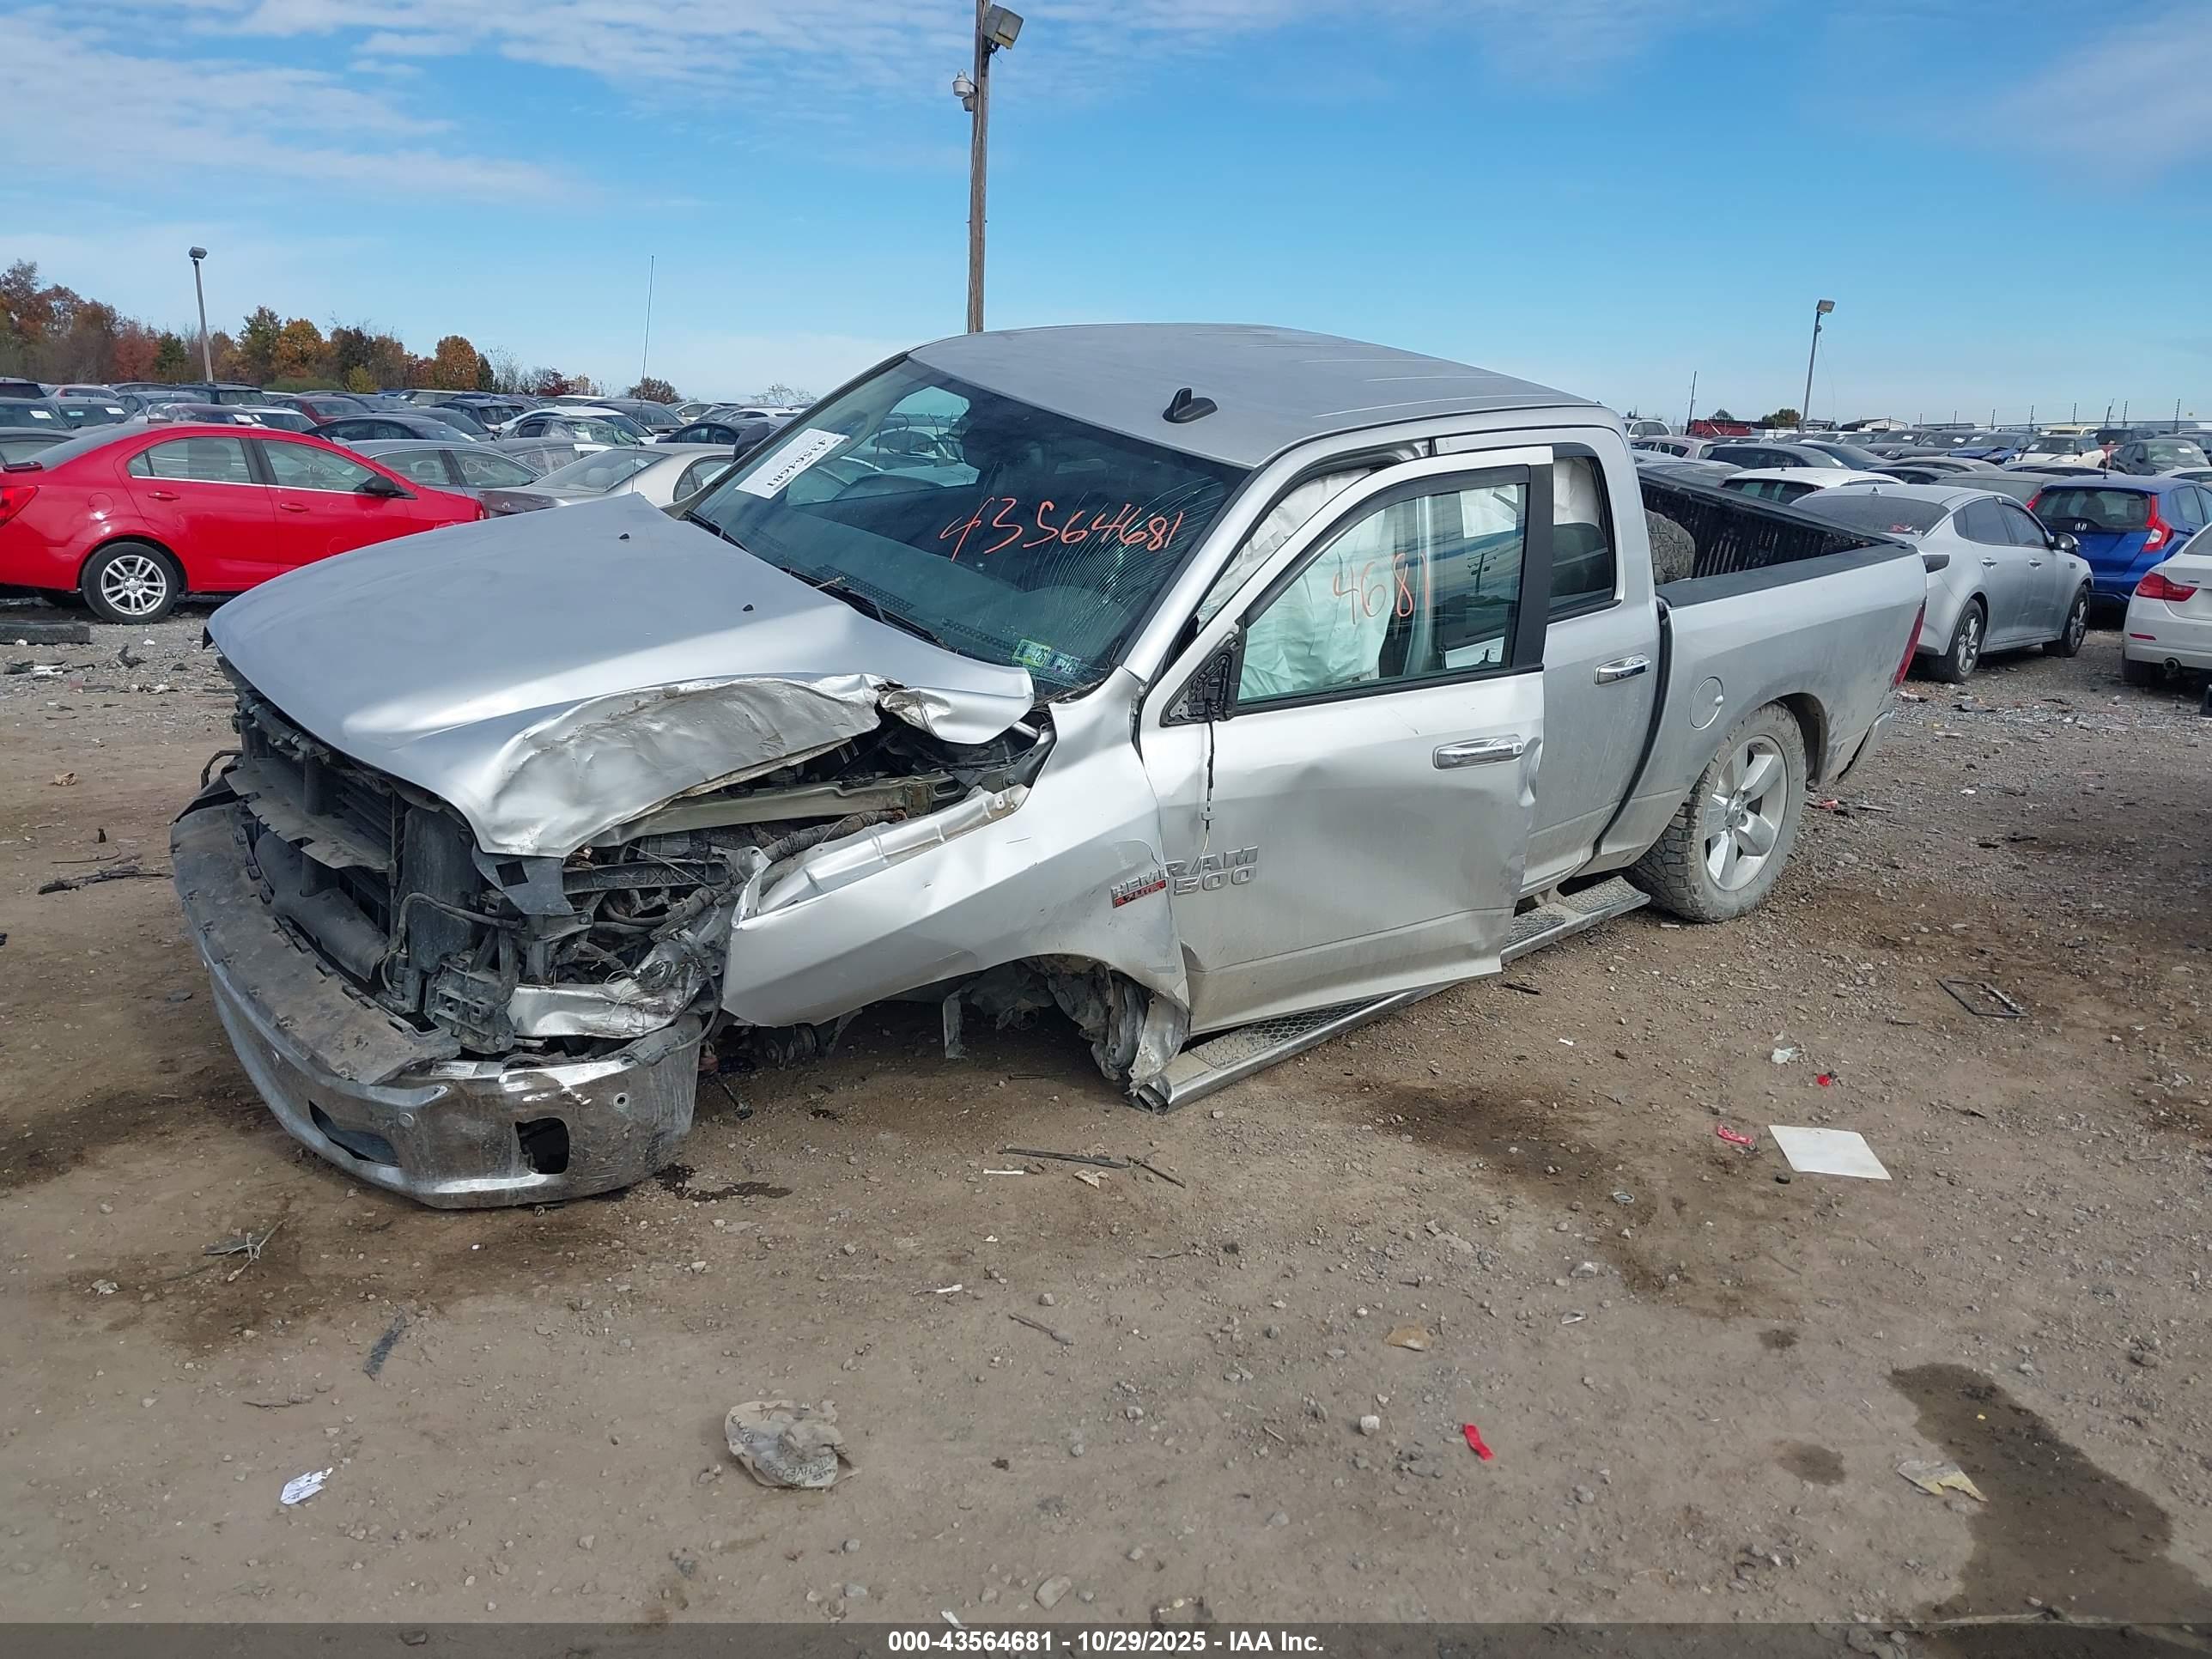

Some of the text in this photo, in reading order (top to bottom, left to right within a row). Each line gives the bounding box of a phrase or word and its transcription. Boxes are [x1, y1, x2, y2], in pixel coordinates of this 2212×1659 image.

[939, 496, 1184, 563] 43564681
[1333, 551, 1431, 626] 4681
[1164, 845, 1259, 877] RAM
[1110, 867, 1166, 897] HEMI
[1173, 866, 1257, 896] 500
